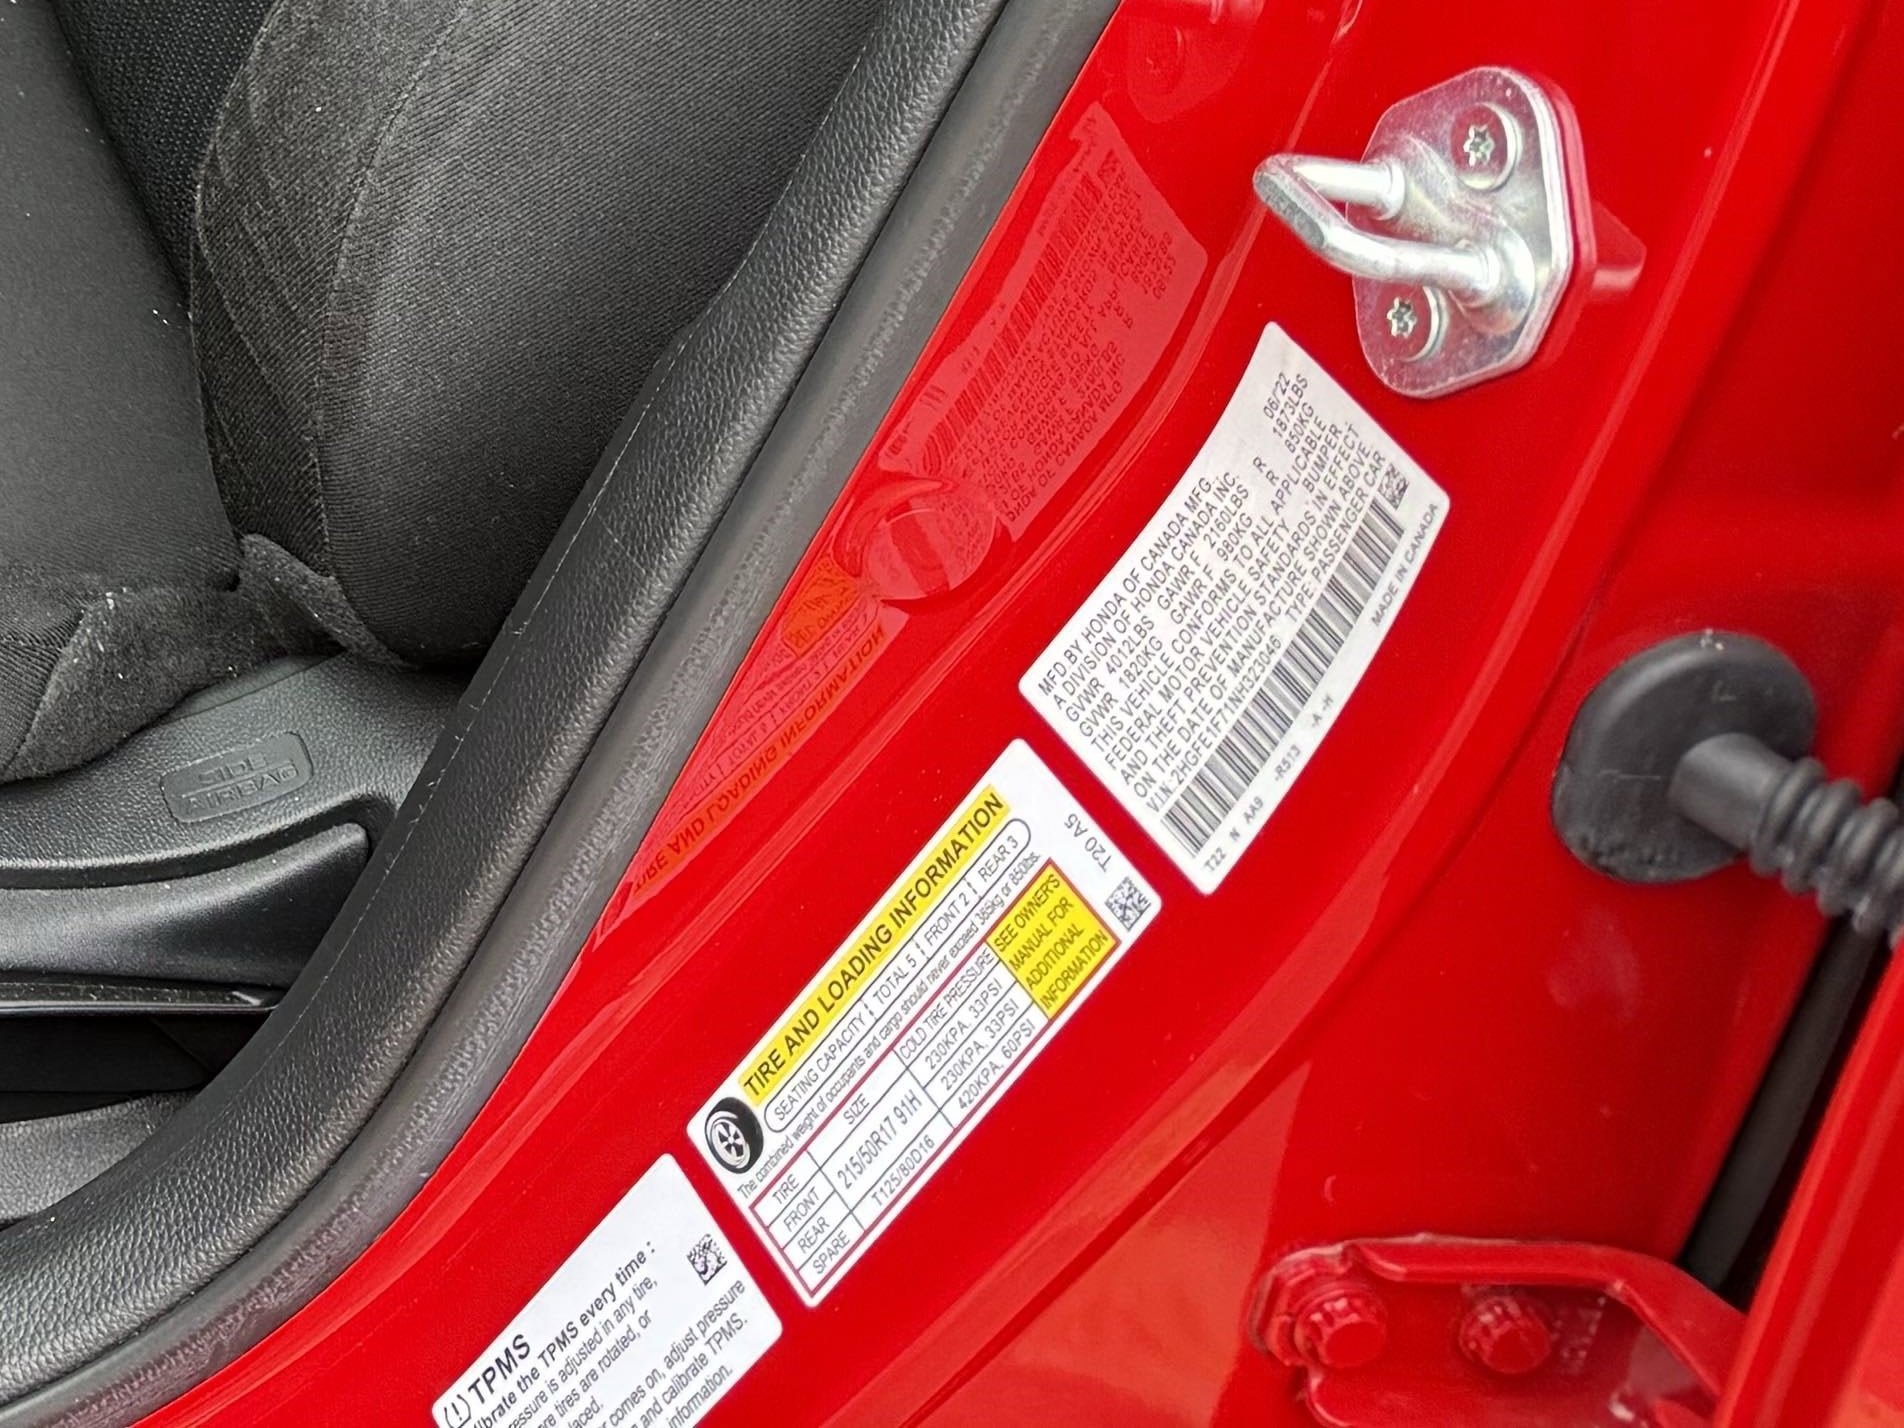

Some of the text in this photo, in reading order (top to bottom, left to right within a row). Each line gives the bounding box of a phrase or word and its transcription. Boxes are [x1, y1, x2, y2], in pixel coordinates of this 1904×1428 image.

[1311, 450, 1386, 583] PASSENGER CAR
[1370, 502, 1438, 626] MADE IN CANADA
[1038, 511, 1189, 696] MFD BY HONDA OF CANADA
[1052, 469, 1239, 710] A DIVISION OF HONDA CANADA INC.
[1064, 455, 1267, 723] GVWR GAWR F R
[1078, 469, 1279, 738] GVWR 1820KG GAWR F R
[1091, 415, 1327, 753] THIS VEHICLE CONFORMS TO ALL APPLICABLE
[1120, 423, 1360, 785] AND THEFT PREVENTION STANDARDS IN EFFECT
[1104, 518, 1291, 770] FEDERAL MOTOR VEHICLE SAFETY
[1133, 499, 1342, 799] ON THE DATE OF MANUFACTURE SHOWN
[187, 760, 299, 813] AIRBAG
[1063, 812, 1113, 872] T20 A5
[743, 792, 1003, 1098] TIRE AND LOADING INFORMATION
[773, 834, 1018, 1122] SEATING CAPACITY TOTAL FRONT 2 REAR 3
[993, 922, 1018, 953] SEE
[1008, 895, 1074, 972] MANUAL FOR
[1025, 921, 1084, 991] ADDITIONAL
[1039, 929, 1109, 1010] INFORMATION
[898, 947, 995, 1060] COLD TIRE PRESSURE
[967, 977, 1003, 1019] 33PSI
[984, 997, 1020, 1040] 33PSI
[737, 919, 979, 1200] The combined weight of and cargo should never exceed
[842, 1093, 870, 1126] SIZE
[772, 1173, 799, 1205] TIRE
[836, 1088, 922, 1190] 215/50R17 91H
[783, 1186, 820, 1232] FRONT
[797, 1215, 830, 1254] REAR
[812, 1230, 850, 1275] SPARE
[467, 1332, 531, 1406] TPMS
[516, 1365, 540, 1394] the
[537, 1320, 579, 1369] TPMS
[578, 1282, 618, 1329] every
[614, 1249, 647, 1286] time
[545, 1376, 559, 1395] is
[556, 1327, 604, 1385] adjusted
[599, 1316, 615, 1336] in
[612, 1295, 637, 1326] any
[553, 1309, 652, 1418] tires are rotated, or
[608, 1279, 746, 1427] comes on, adjust pressure
[639, 1310, 748, 1428] and calibrate TPMS.
